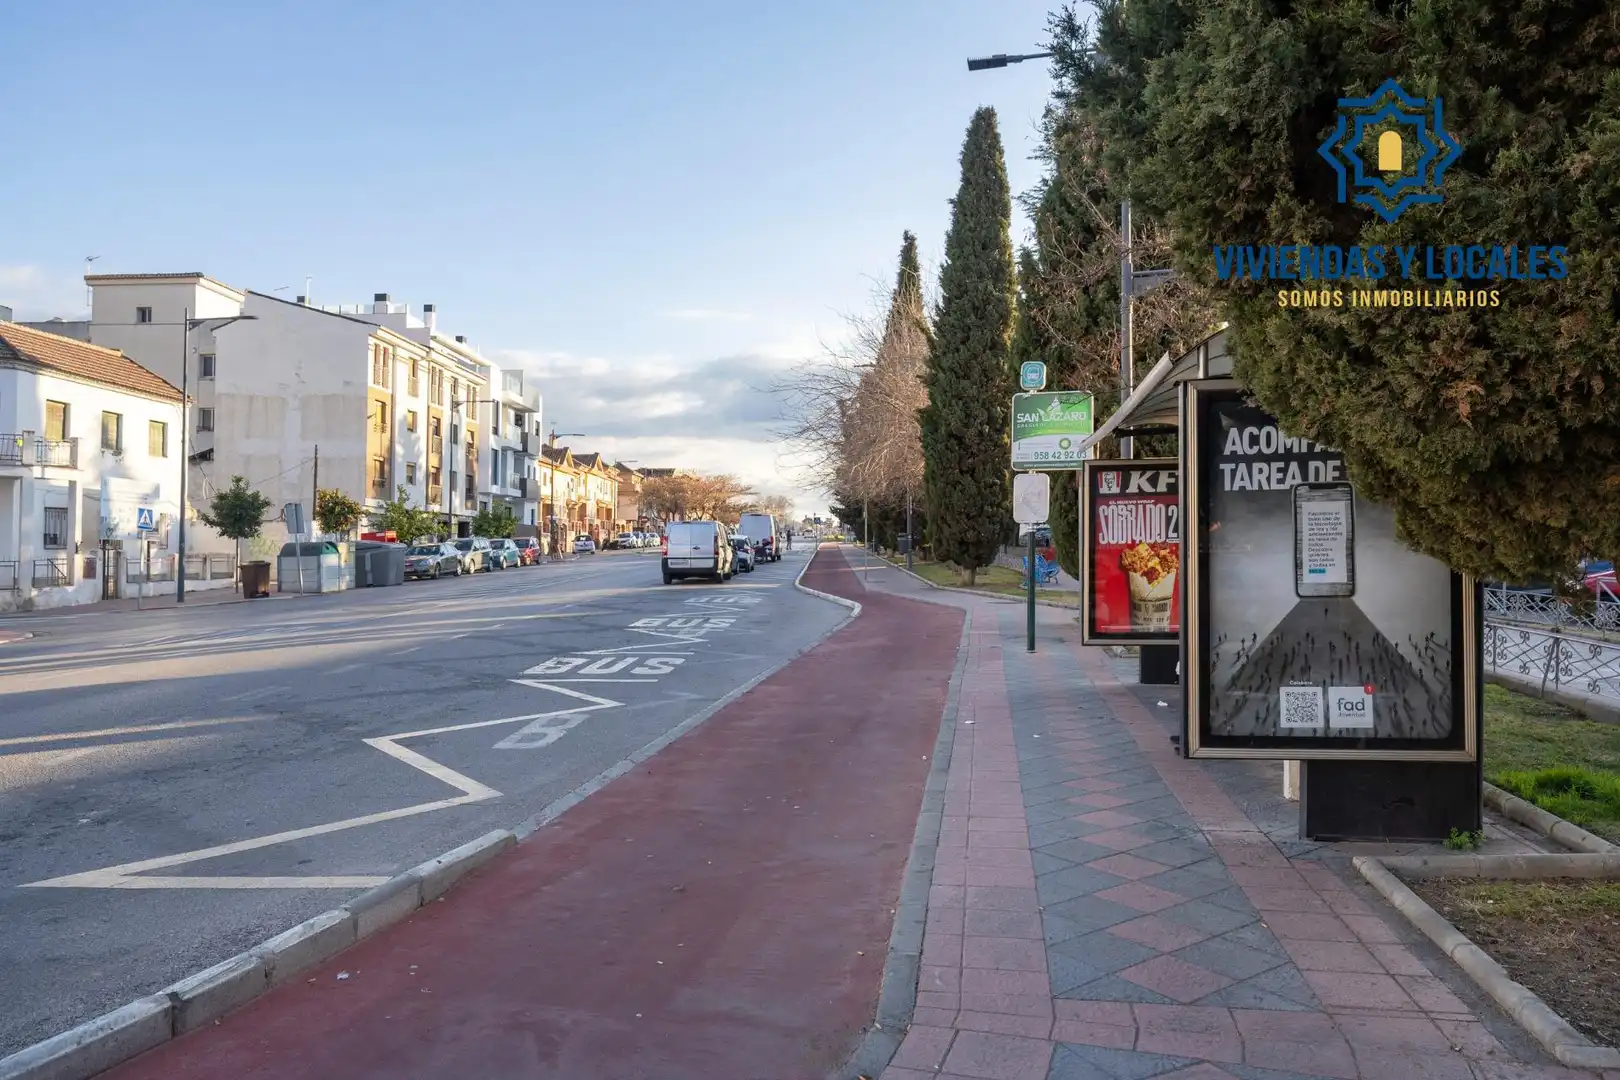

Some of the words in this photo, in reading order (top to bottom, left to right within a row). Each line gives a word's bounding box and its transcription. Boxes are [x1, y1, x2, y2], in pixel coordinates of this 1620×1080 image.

[1016, 412, 1039, 423] SAN
[1033, 451, 1049, 460] 958
[1051, 451, 1062, 459] 42
[1064, 451, 1075, 459] 92
[1219, 461, 1303, 491] TAREA
[1308, 460, 1341, 482] DE
[627, 618, 737, 629] BUS
[519, 656, 686, 676] BUS
[1336, 697, 1366, 712] fad
